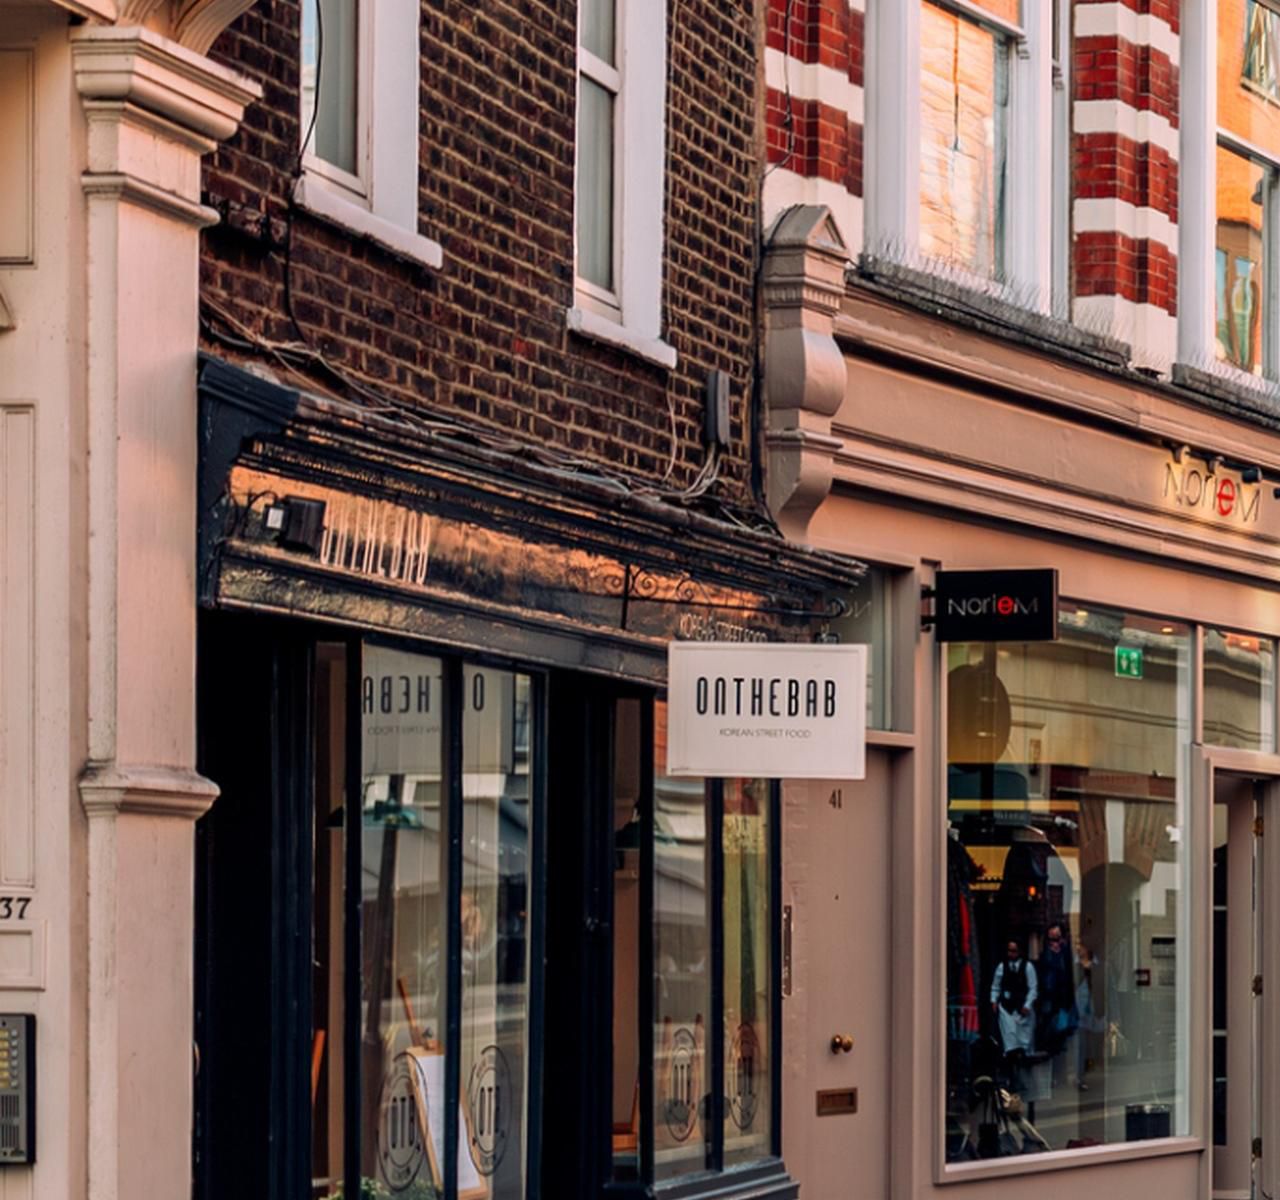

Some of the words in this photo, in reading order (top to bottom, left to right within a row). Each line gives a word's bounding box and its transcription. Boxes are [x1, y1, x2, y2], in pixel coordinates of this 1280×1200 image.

[696, 676, 837, 718] ONTHEBAB
[719, 727, 754, 739] KOREAN
[755, 728, 784, 740] STREET
[785, 729, 812, 741] FOOD
[828, 788, 843, 810] 41
[0, 896, 33, 921] 37
